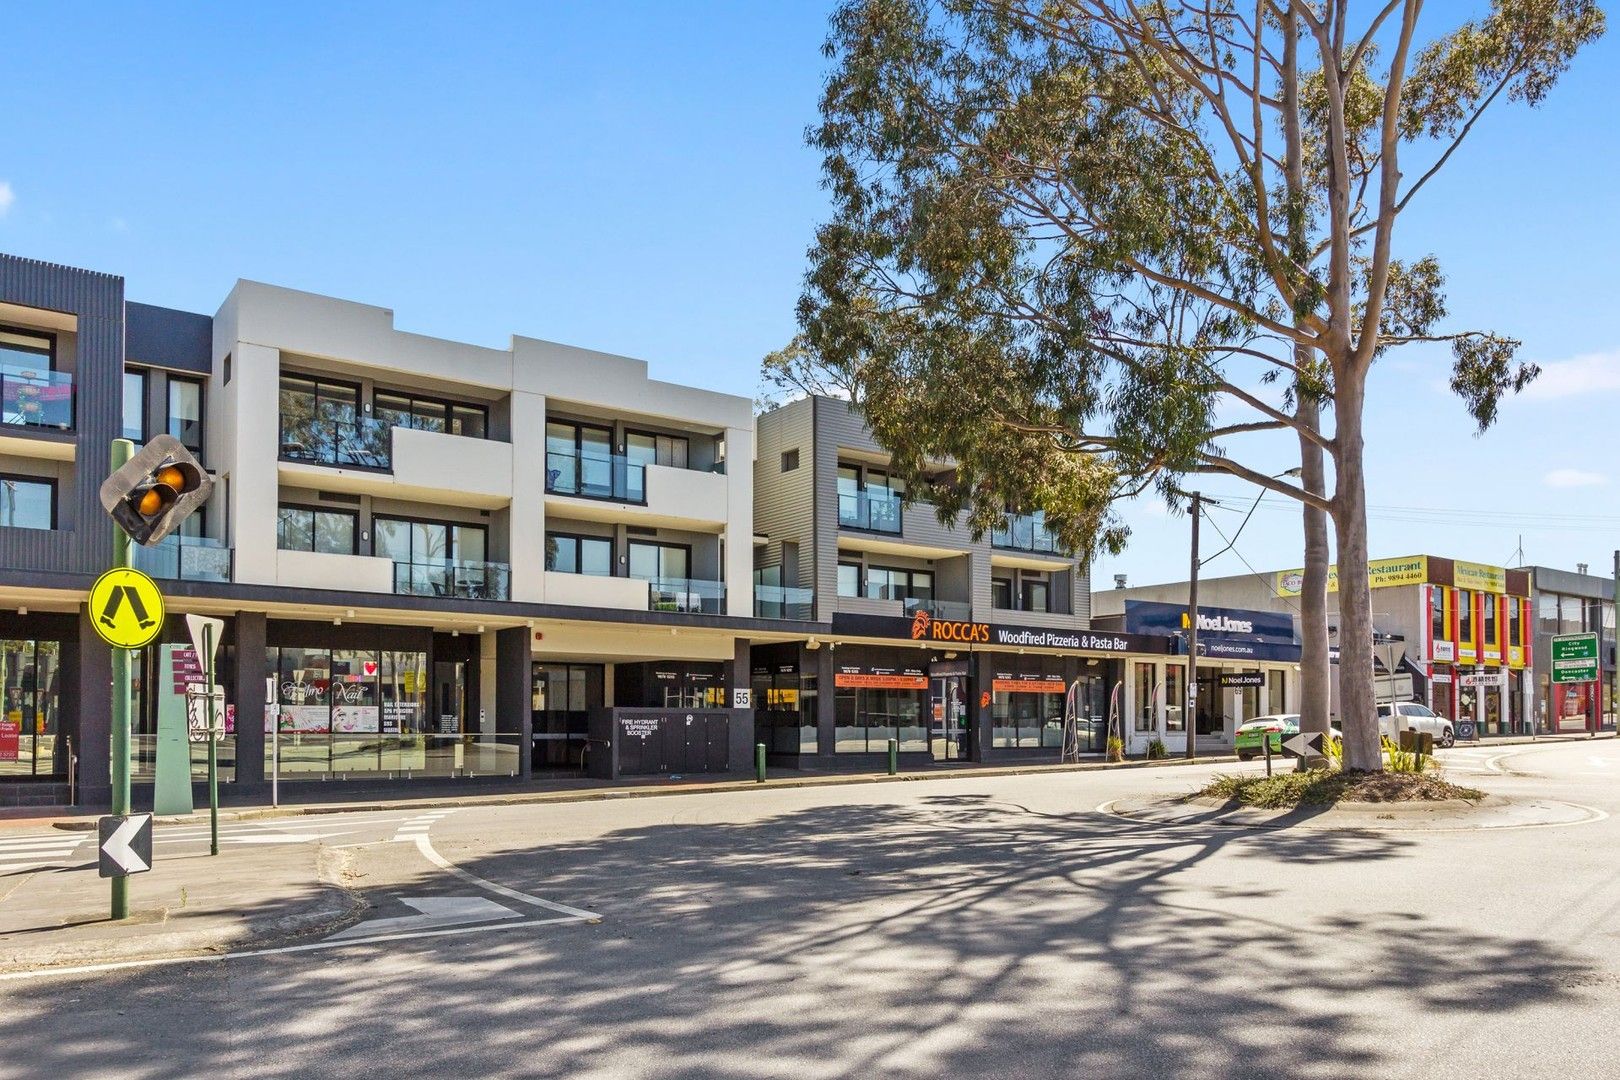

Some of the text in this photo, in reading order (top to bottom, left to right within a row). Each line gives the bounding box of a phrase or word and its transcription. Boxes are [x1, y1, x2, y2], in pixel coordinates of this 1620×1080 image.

[933, 621, 990, 642] ROCCA'S
[998, 630, 1128, 650] Woodfired Pizzeria & Pasta Bar
[1211, 645, 1254, 654] noeljones.com.au
[735, 692, 749, 705] 55
